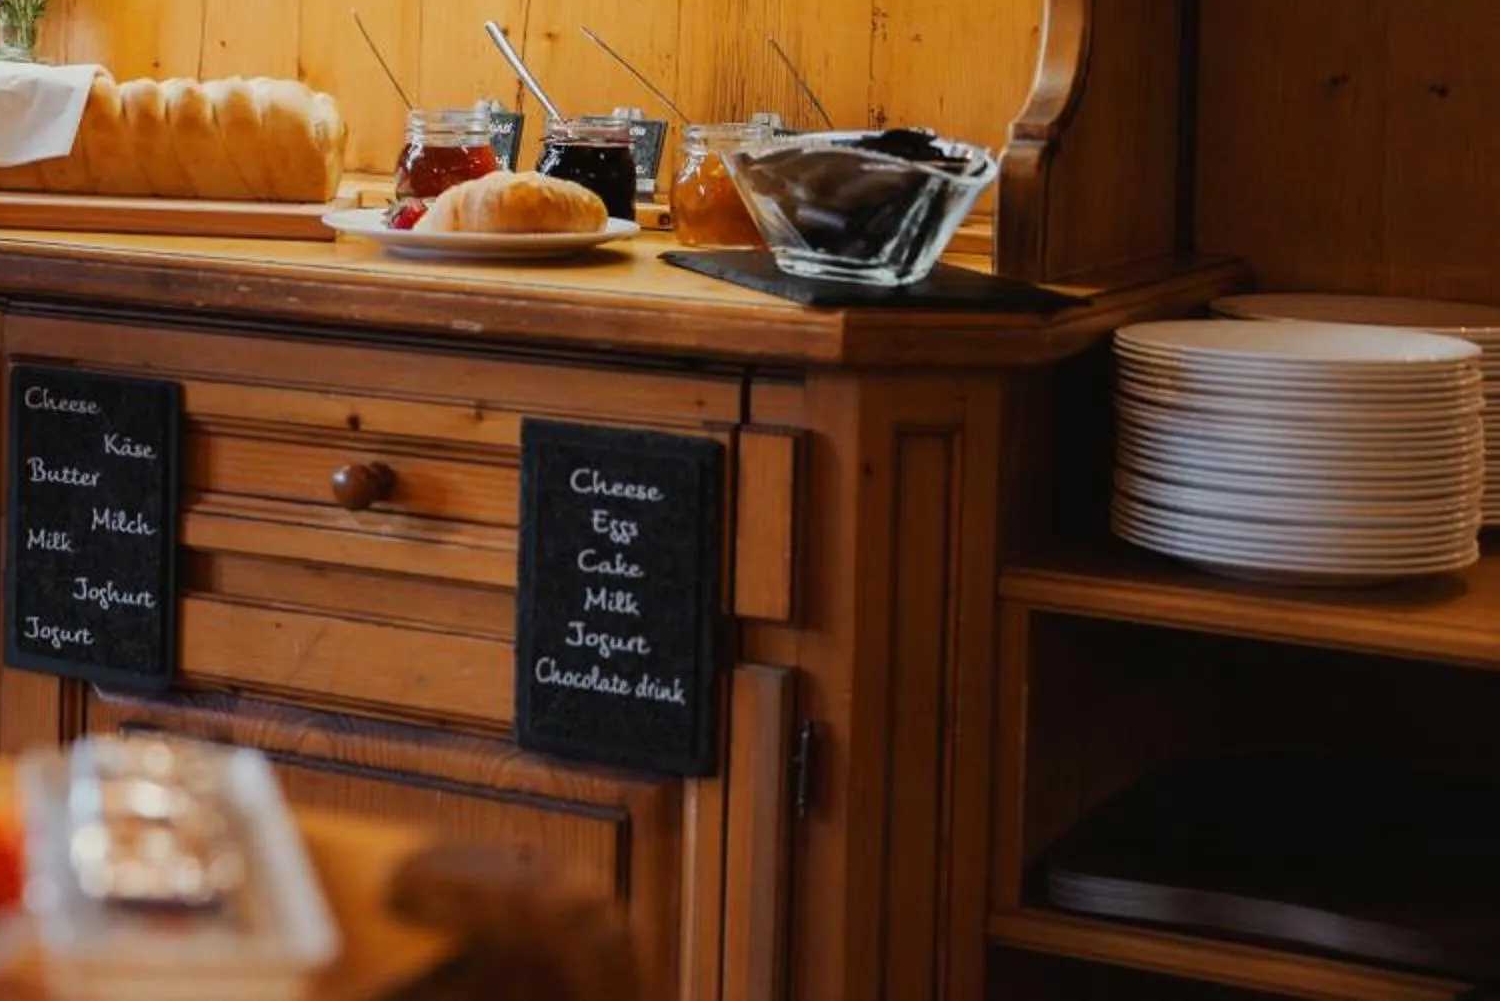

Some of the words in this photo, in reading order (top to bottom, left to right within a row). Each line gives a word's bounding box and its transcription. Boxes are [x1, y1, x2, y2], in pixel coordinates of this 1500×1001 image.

[25, 387, 100, 414] Cheese
[103, 433, 156, 460] Käse
[27, 457, 100, 486] Butter
[570, 468, 664, 501] Cheese
[91, 508, 156, 536] Milch
[591, 510, 639, 544] Eggs
[27, 528, 73, 552] Milk
[577, 549, 644, 577] Cake
[73, 577, 155, 609] Joghurt
[584, 587, 640, 615] Milk
[24, 616, 95, 647] Jogurt
[565, 621, 651, 657] Jogurt
[535, 657, 631, 696] Chocolate
[635, 675, 685, 705] drink
